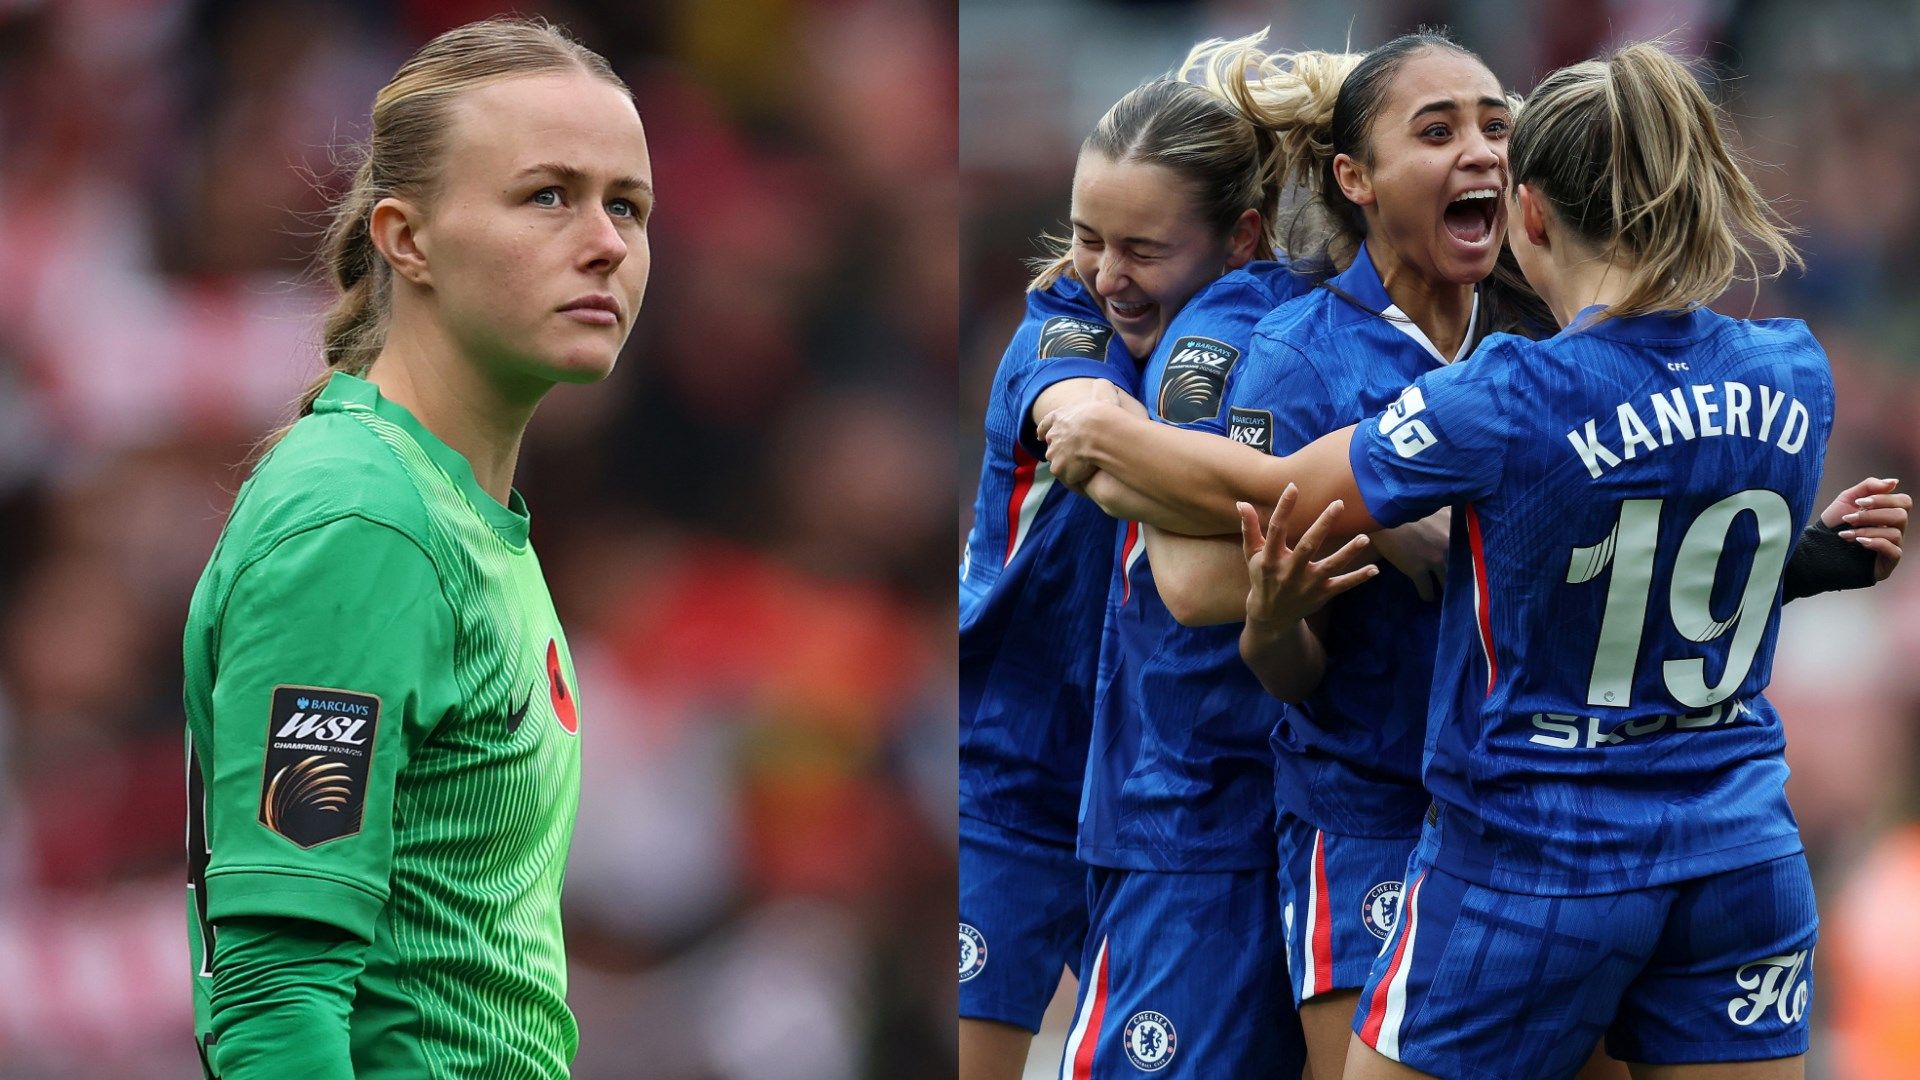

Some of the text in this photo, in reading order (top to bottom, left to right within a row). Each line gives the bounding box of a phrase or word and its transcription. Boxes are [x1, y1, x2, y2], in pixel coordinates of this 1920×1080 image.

[1195, 342, 1232, 357] BARCLAYS
[1170, 349, 1228, 370] WSL
[1667, 362, 1690, 371] CFC
[1236, 416, 1265, 426] BARCLAYS
[1229, 425, 1267, 446] WSL
[1566, 381, 1809, 480] KANERYD
[1566, 489, 1792, 708] 19
[311, 699, 369, 716] BARCLAYS
[275, 712, 368, 746] WSL
[274, 742, 363, 757] CHAMPIONS 2024/25
[1372, 883, 1400, 898] CHELS
[1727, 949, 1808, 1026] Flo
[1133, 1013, 1168, 1028] CHELSEA
